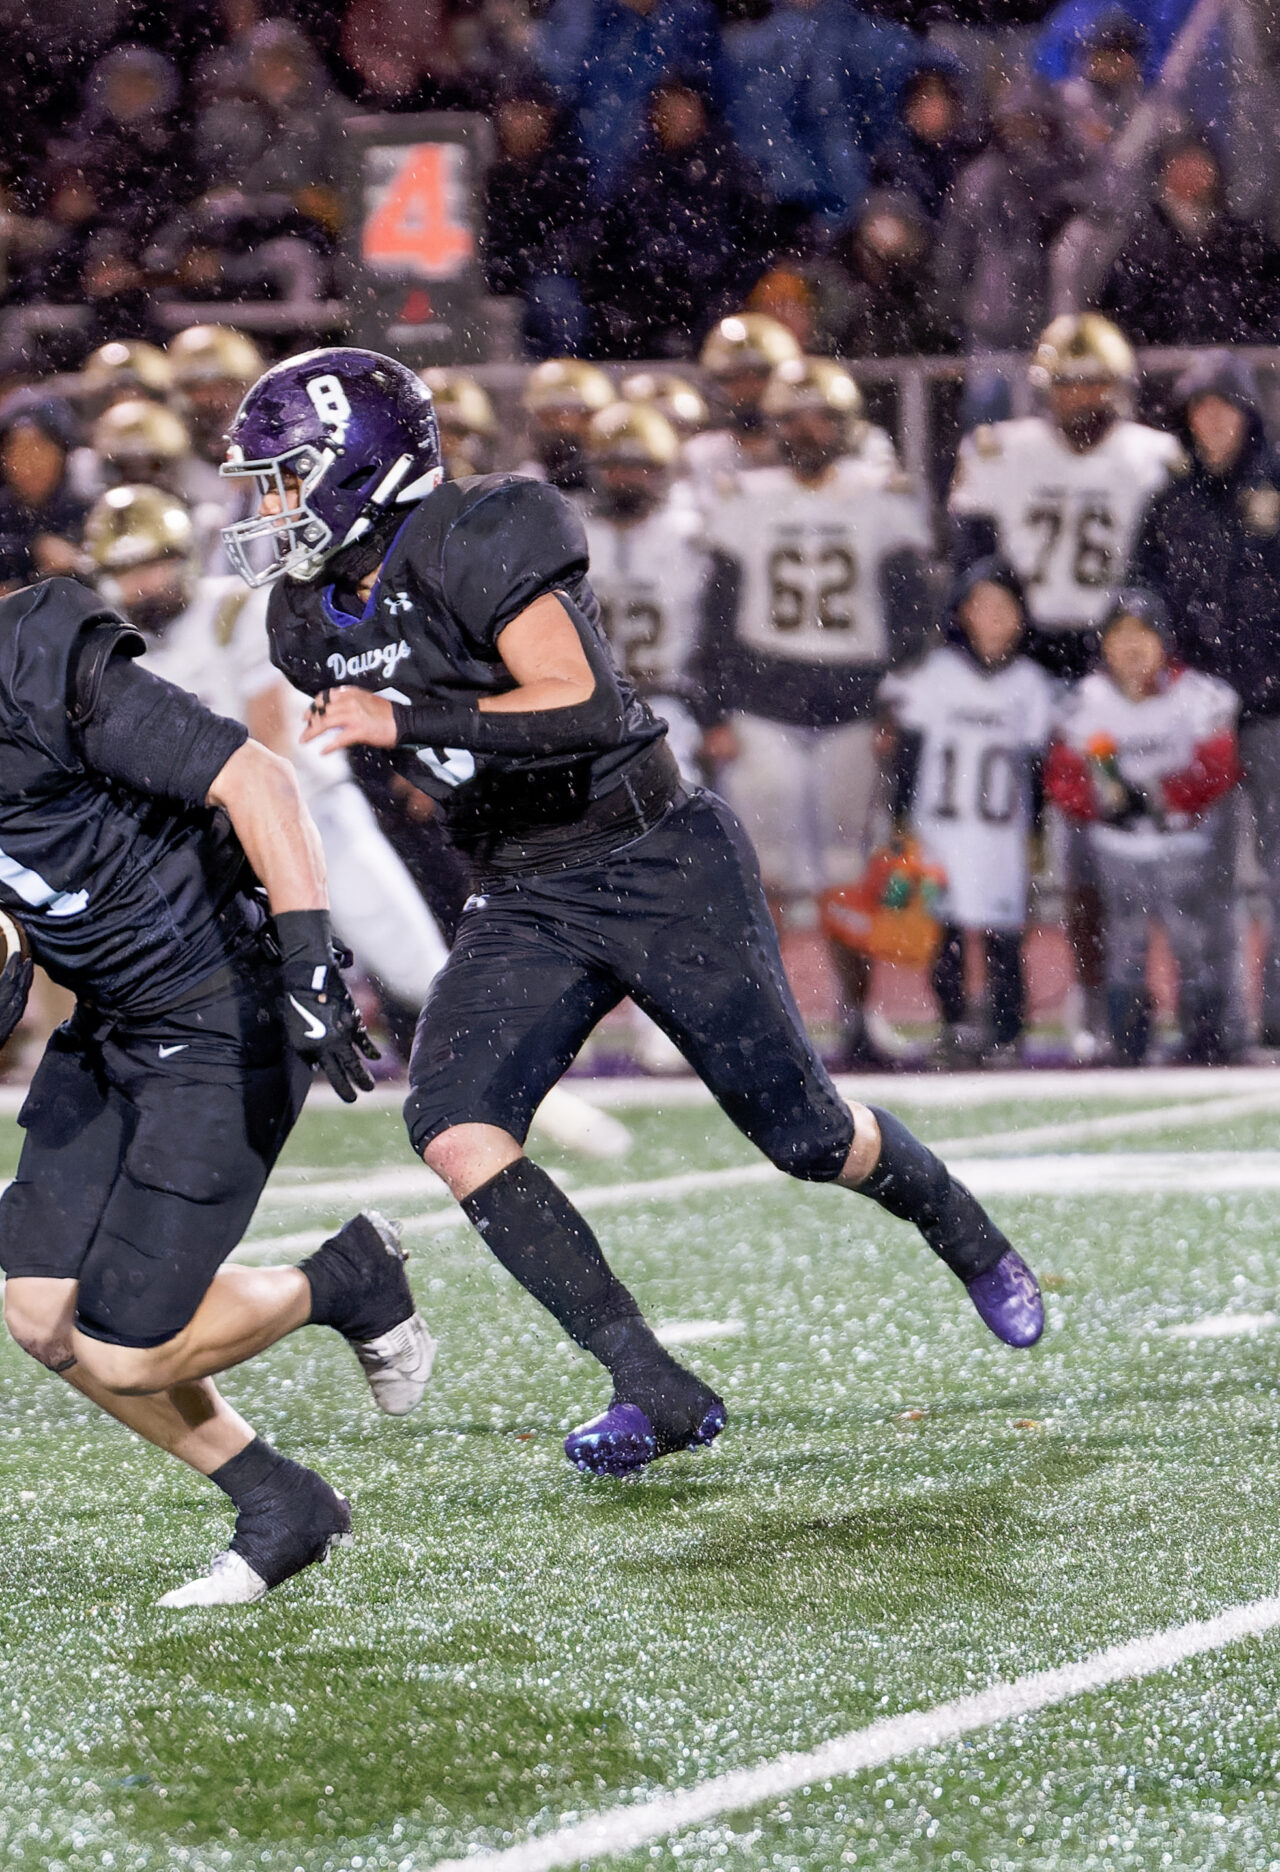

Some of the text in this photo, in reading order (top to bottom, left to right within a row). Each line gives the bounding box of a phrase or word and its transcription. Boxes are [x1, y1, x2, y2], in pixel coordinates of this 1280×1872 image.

[362, 142, 473, 268] 4
[306, 374, 352, 425] 8
[1024, 506, 1115, 587] 76
[768, 546, 859, 631] 62
[326, 639, 412, 680] Dawgs
[932, 742, 1017, 822] 10
